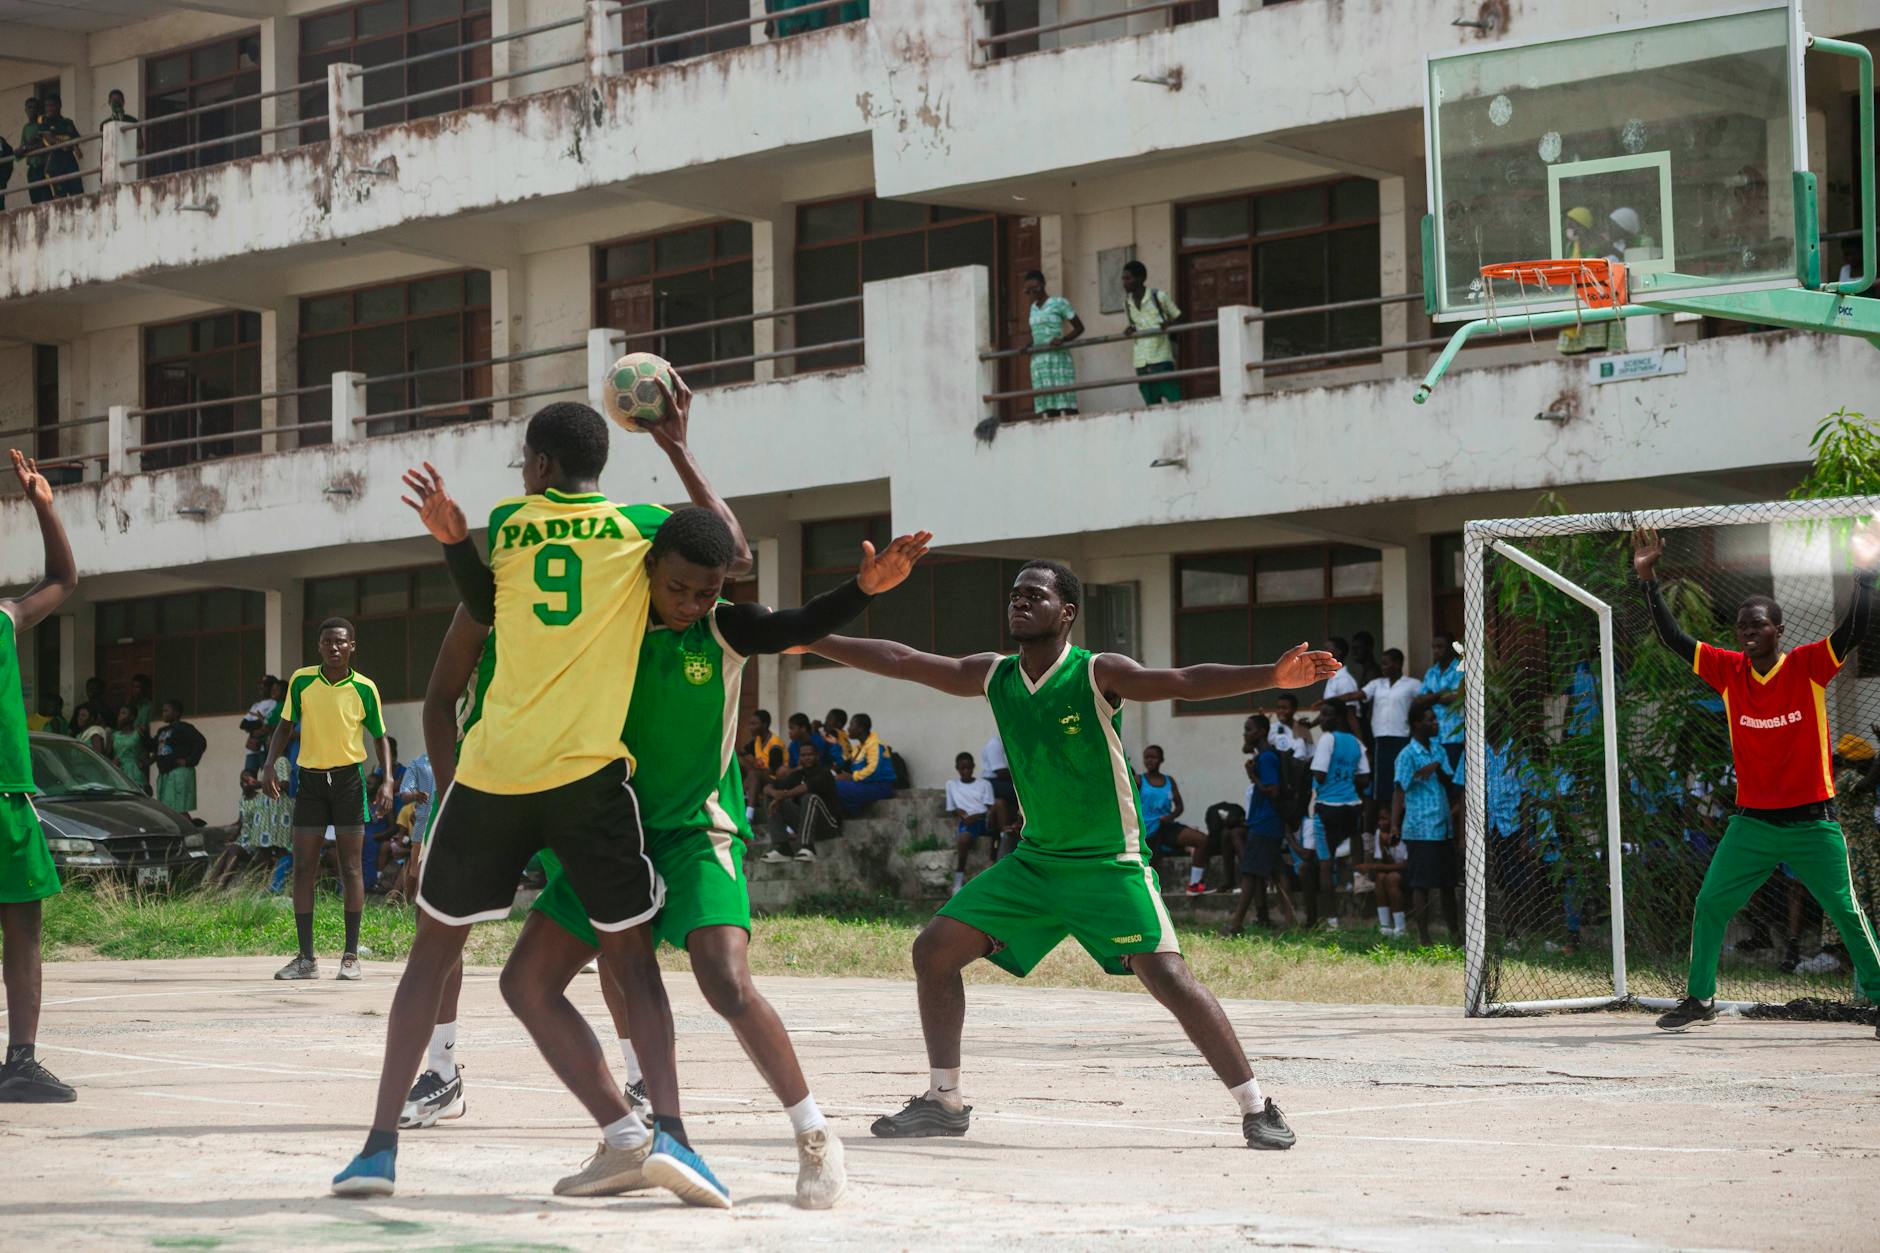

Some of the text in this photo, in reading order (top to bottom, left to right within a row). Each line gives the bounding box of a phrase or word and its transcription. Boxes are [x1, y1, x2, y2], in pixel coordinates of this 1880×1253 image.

[1623, 357, 1652, 367] SCIENCE
[1618, 364, 1657, 375] DEPARTMENT
[502, 516, 624, 549] PADUA
[532, 543, 583, 626] 9
[1787, 709, 1803, 723] 93
